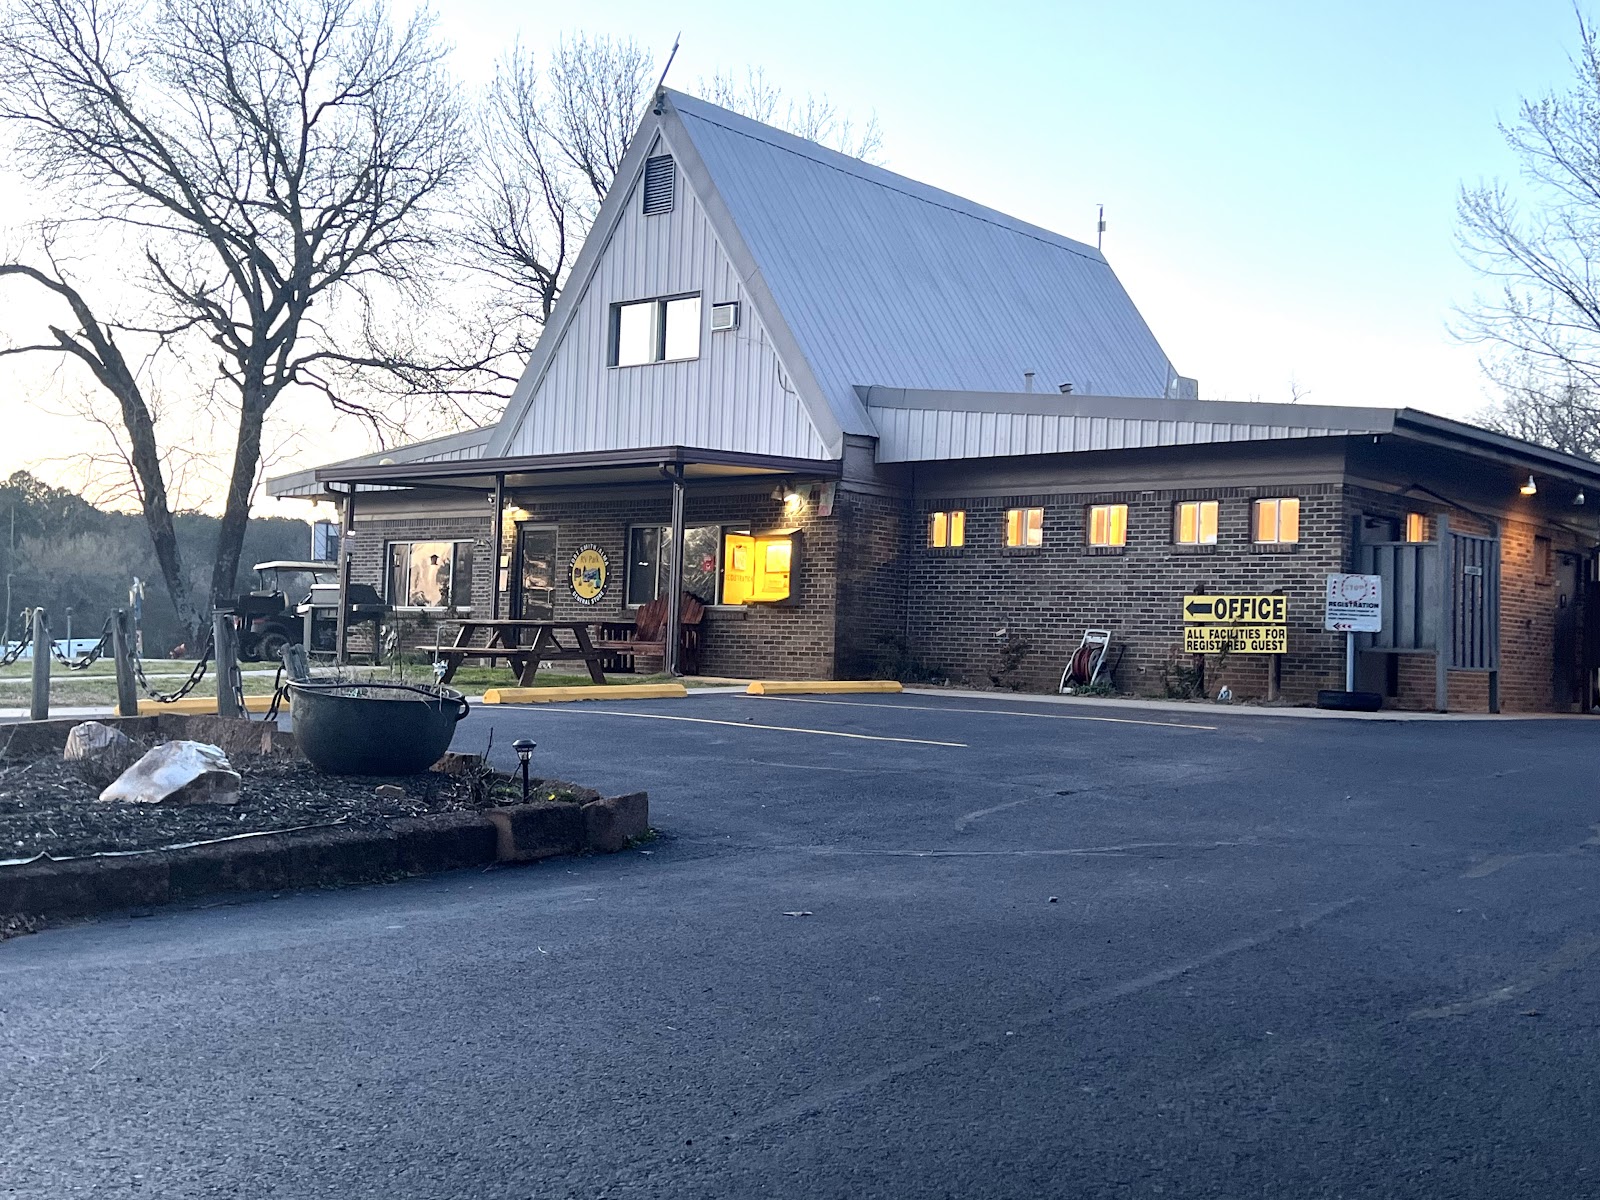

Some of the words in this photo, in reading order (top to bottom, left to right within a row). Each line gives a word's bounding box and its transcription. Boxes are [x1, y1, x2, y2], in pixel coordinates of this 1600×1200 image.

[1214, 598, 1284, 620] OFFICE
[1187, 629, 1205, 639] ALL
[1209, 629, 1261, 639] FACILITIES
[1265, 629, 1285, 639] FOR
[1186, 640, 1246, 650] REGISTERED
[1251, 640, 1284, 650] GUEST
